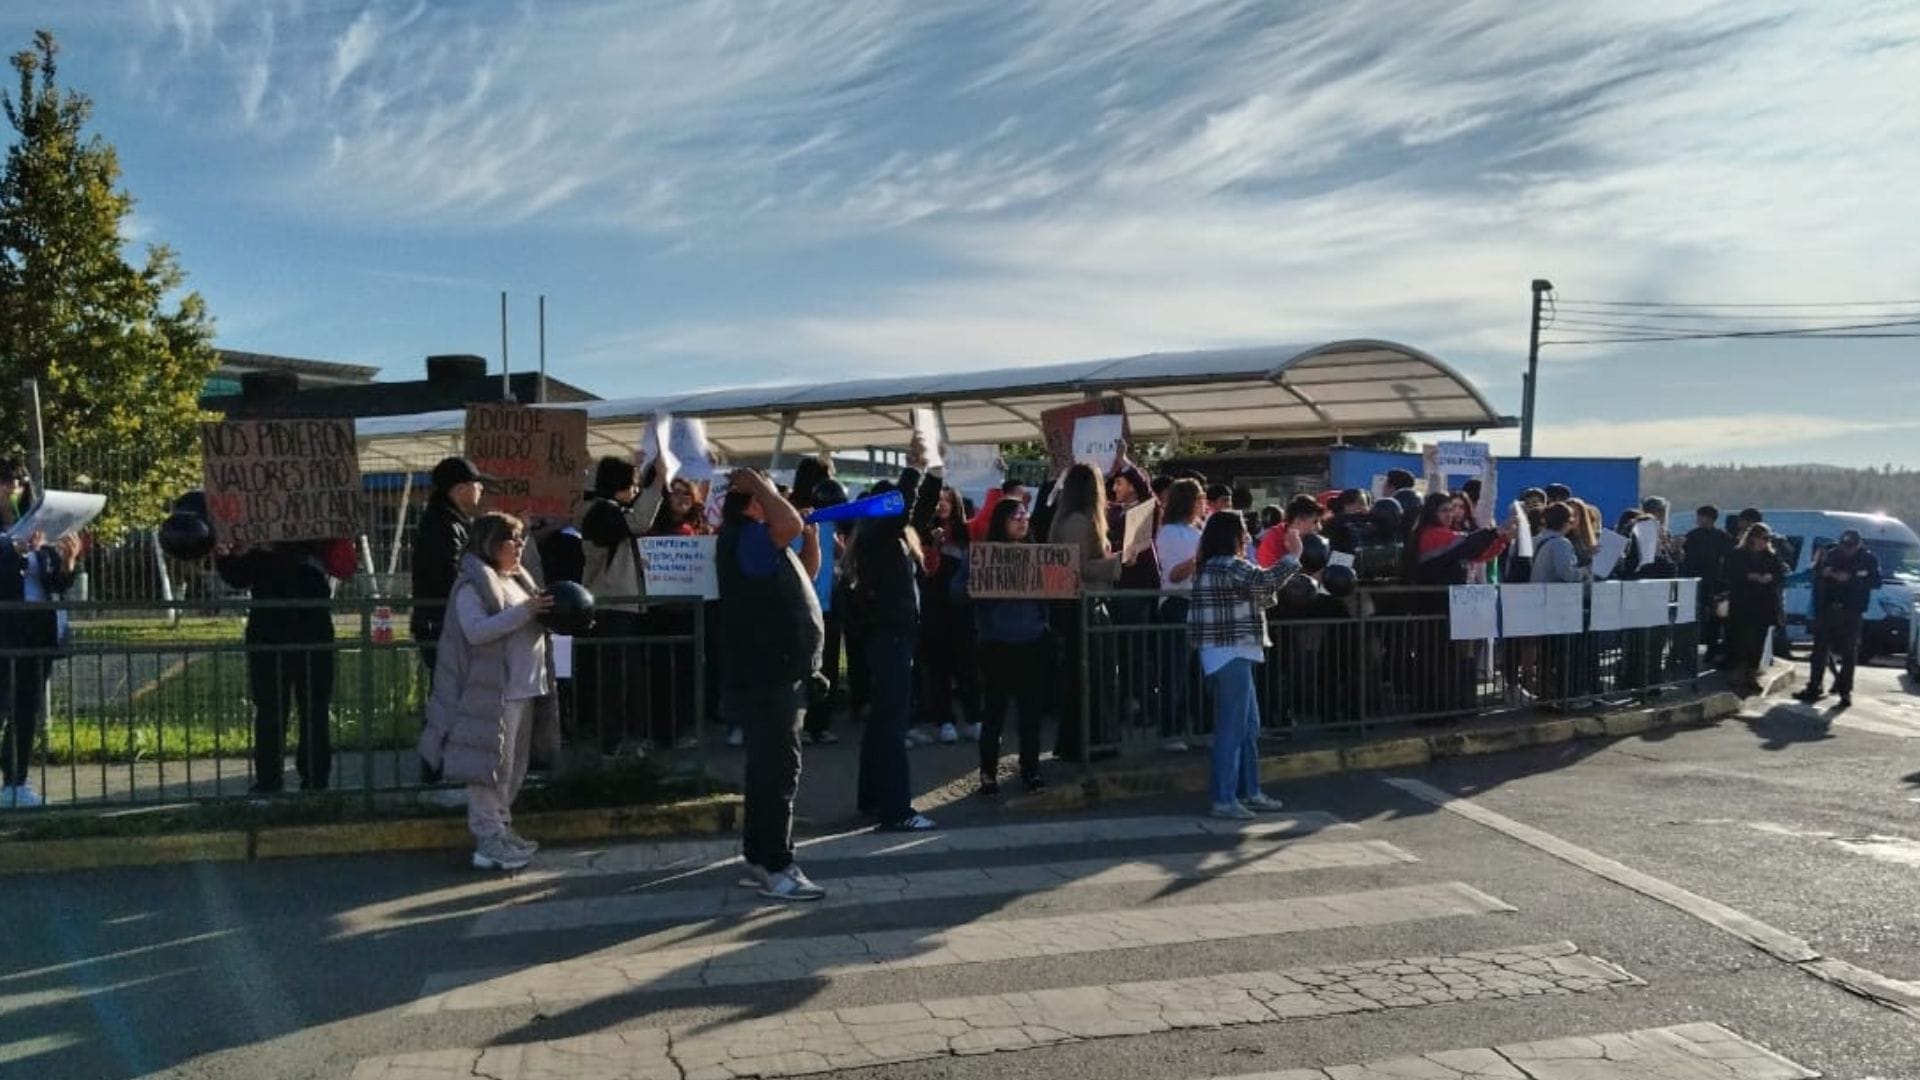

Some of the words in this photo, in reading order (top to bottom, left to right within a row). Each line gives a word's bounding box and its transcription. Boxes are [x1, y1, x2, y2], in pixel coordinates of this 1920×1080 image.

[204, 422, 249, 457] NOS
[256, 420, 353, 457] PIDIERON
[208, 460, 305, 493] VALORES
